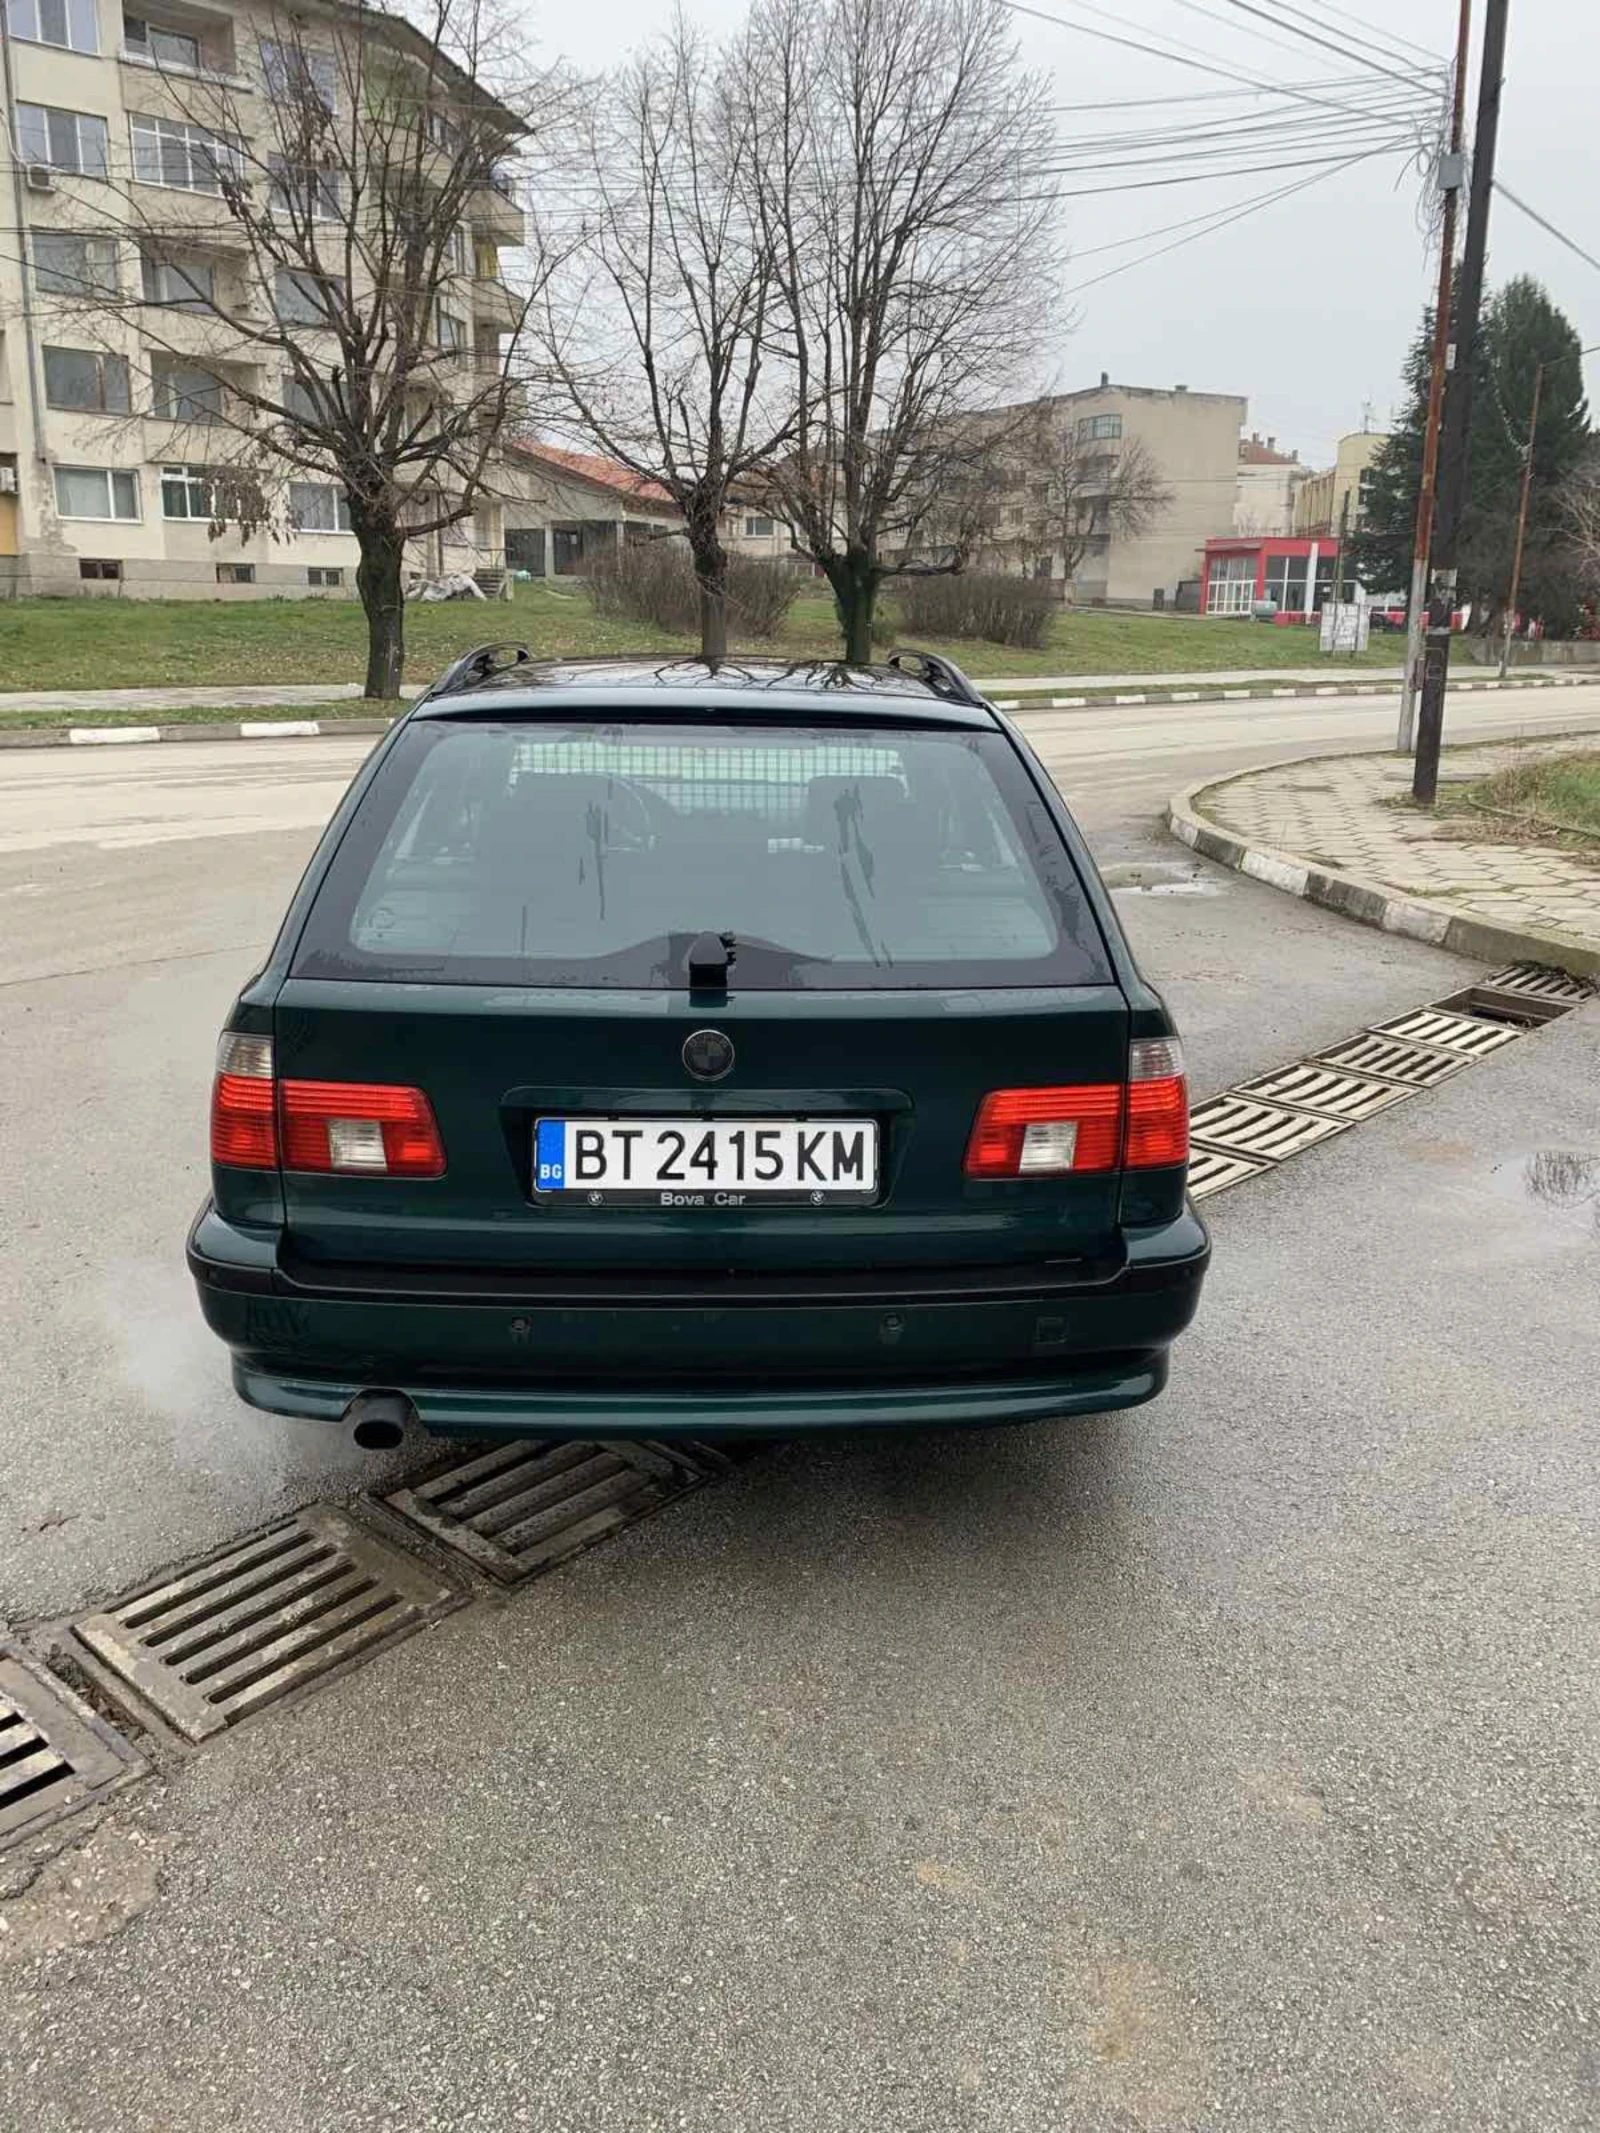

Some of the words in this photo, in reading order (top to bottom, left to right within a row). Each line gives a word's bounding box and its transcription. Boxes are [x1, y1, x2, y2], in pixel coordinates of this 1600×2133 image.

[575, 1129, 643, 1180] BT
[656, 1130, 784, 1181] 2415
[797, 1131, 864, 1181] KM
[540, 1164, 562, 1179] BG
[660, 1192, 705, 1206] Bova
[714, 1192, 747, 1206] Car
